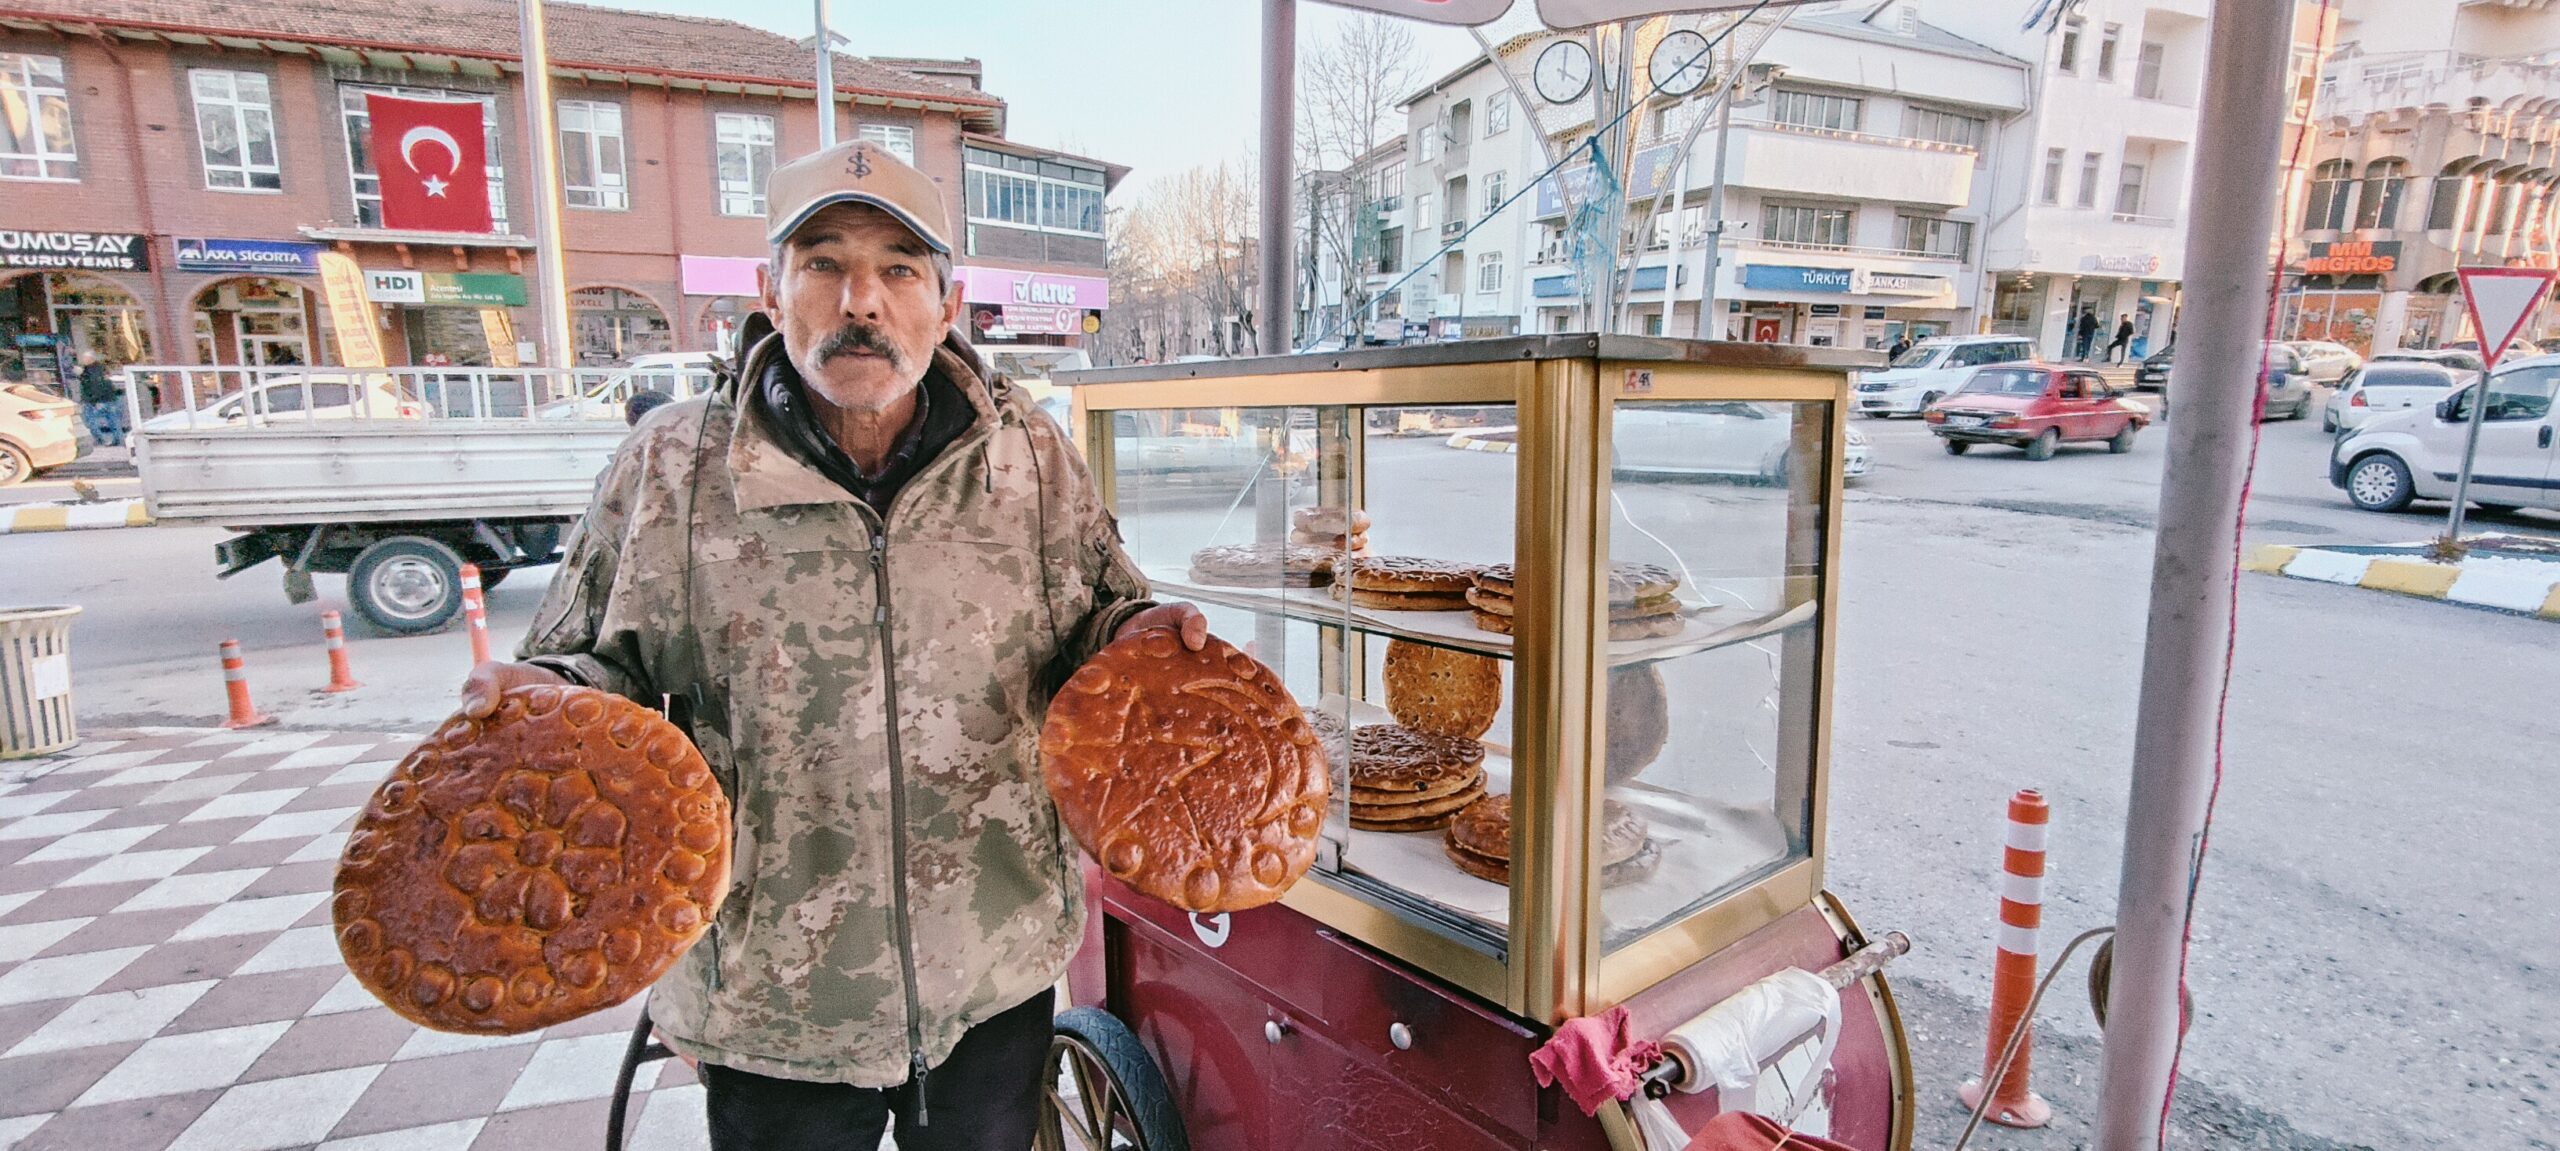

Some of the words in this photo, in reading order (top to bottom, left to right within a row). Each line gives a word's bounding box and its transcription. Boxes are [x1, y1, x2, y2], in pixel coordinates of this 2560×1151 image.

[206, 249, 237, 261] AXA
[238, 250, 301, 263] SİGORTA
[2329, 242, 2372, 257] MM
[10, 254, 135, 269] KURUYEMİŞ
[375, 276, 414, 290] HDI
[1802, 271, 1849, 286] TÜRKİYE
[1031, 282, 1076, 304] ALTUS
